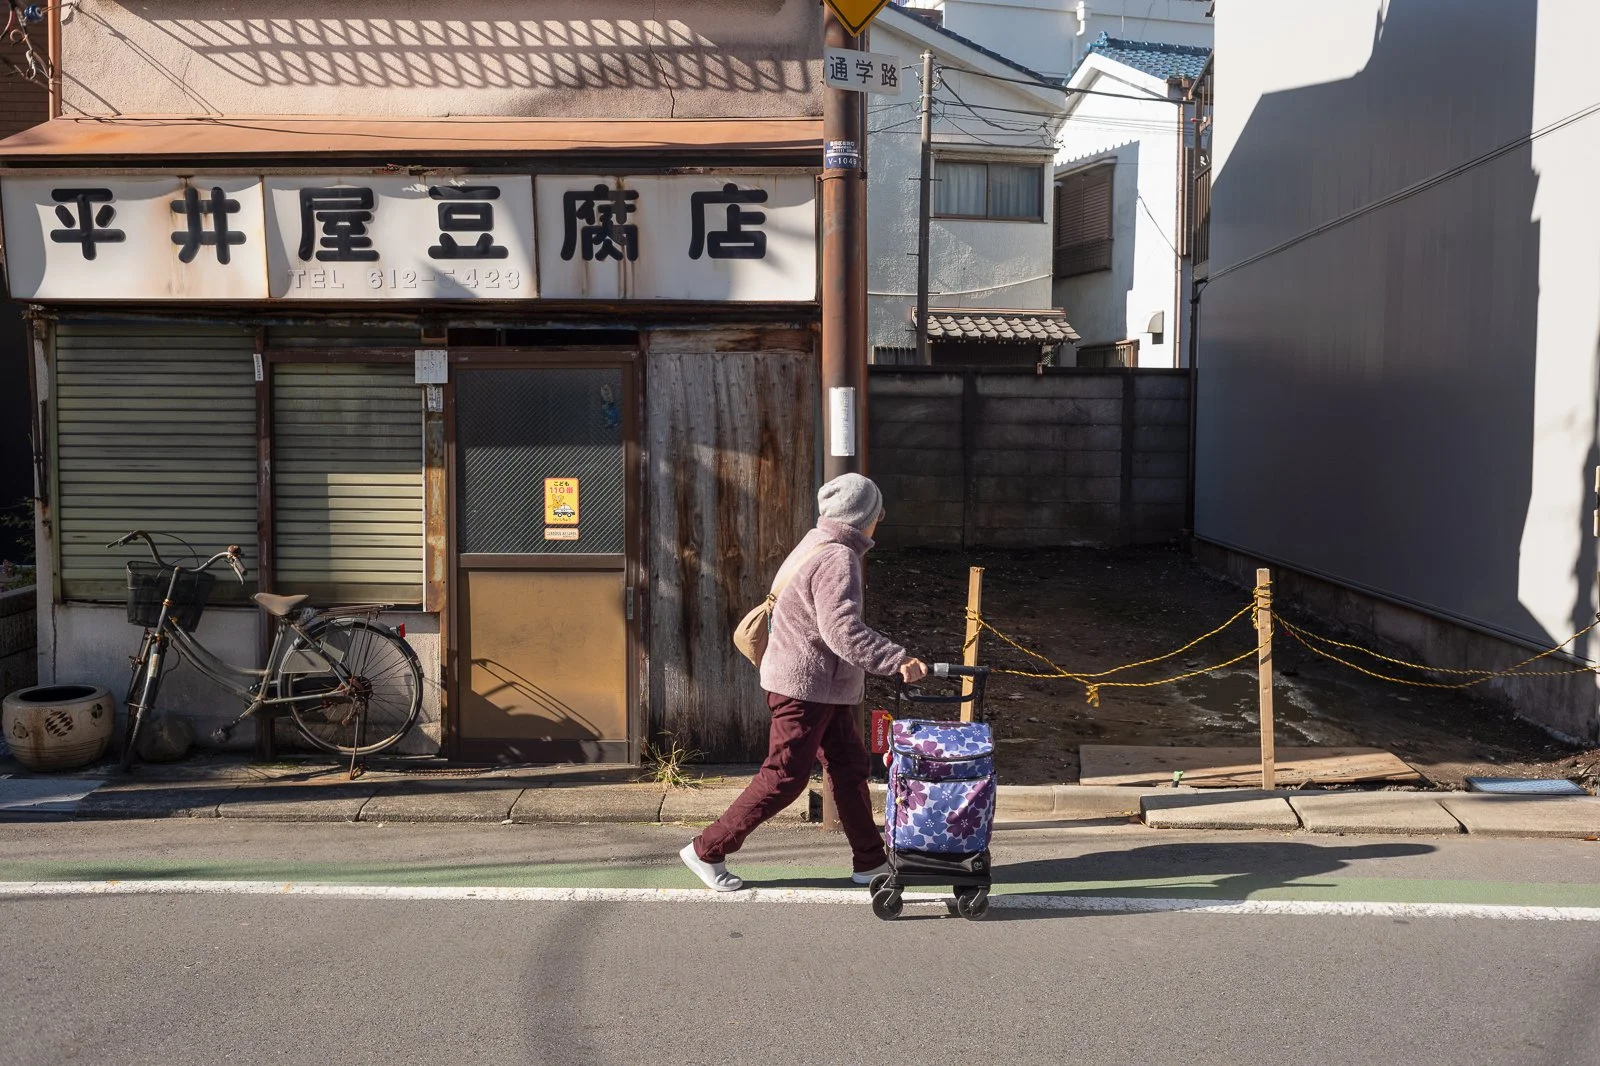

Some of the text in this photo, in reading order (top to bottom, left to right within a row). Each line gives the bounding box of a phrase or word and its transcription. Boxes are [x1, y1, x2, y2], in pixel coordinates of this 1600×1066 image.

[830, 56, 898, 87] 通学路
[51, 183, 768, 264] 平井屋豆腐店
[288, 268, 520, 289] TEL 612-5423
